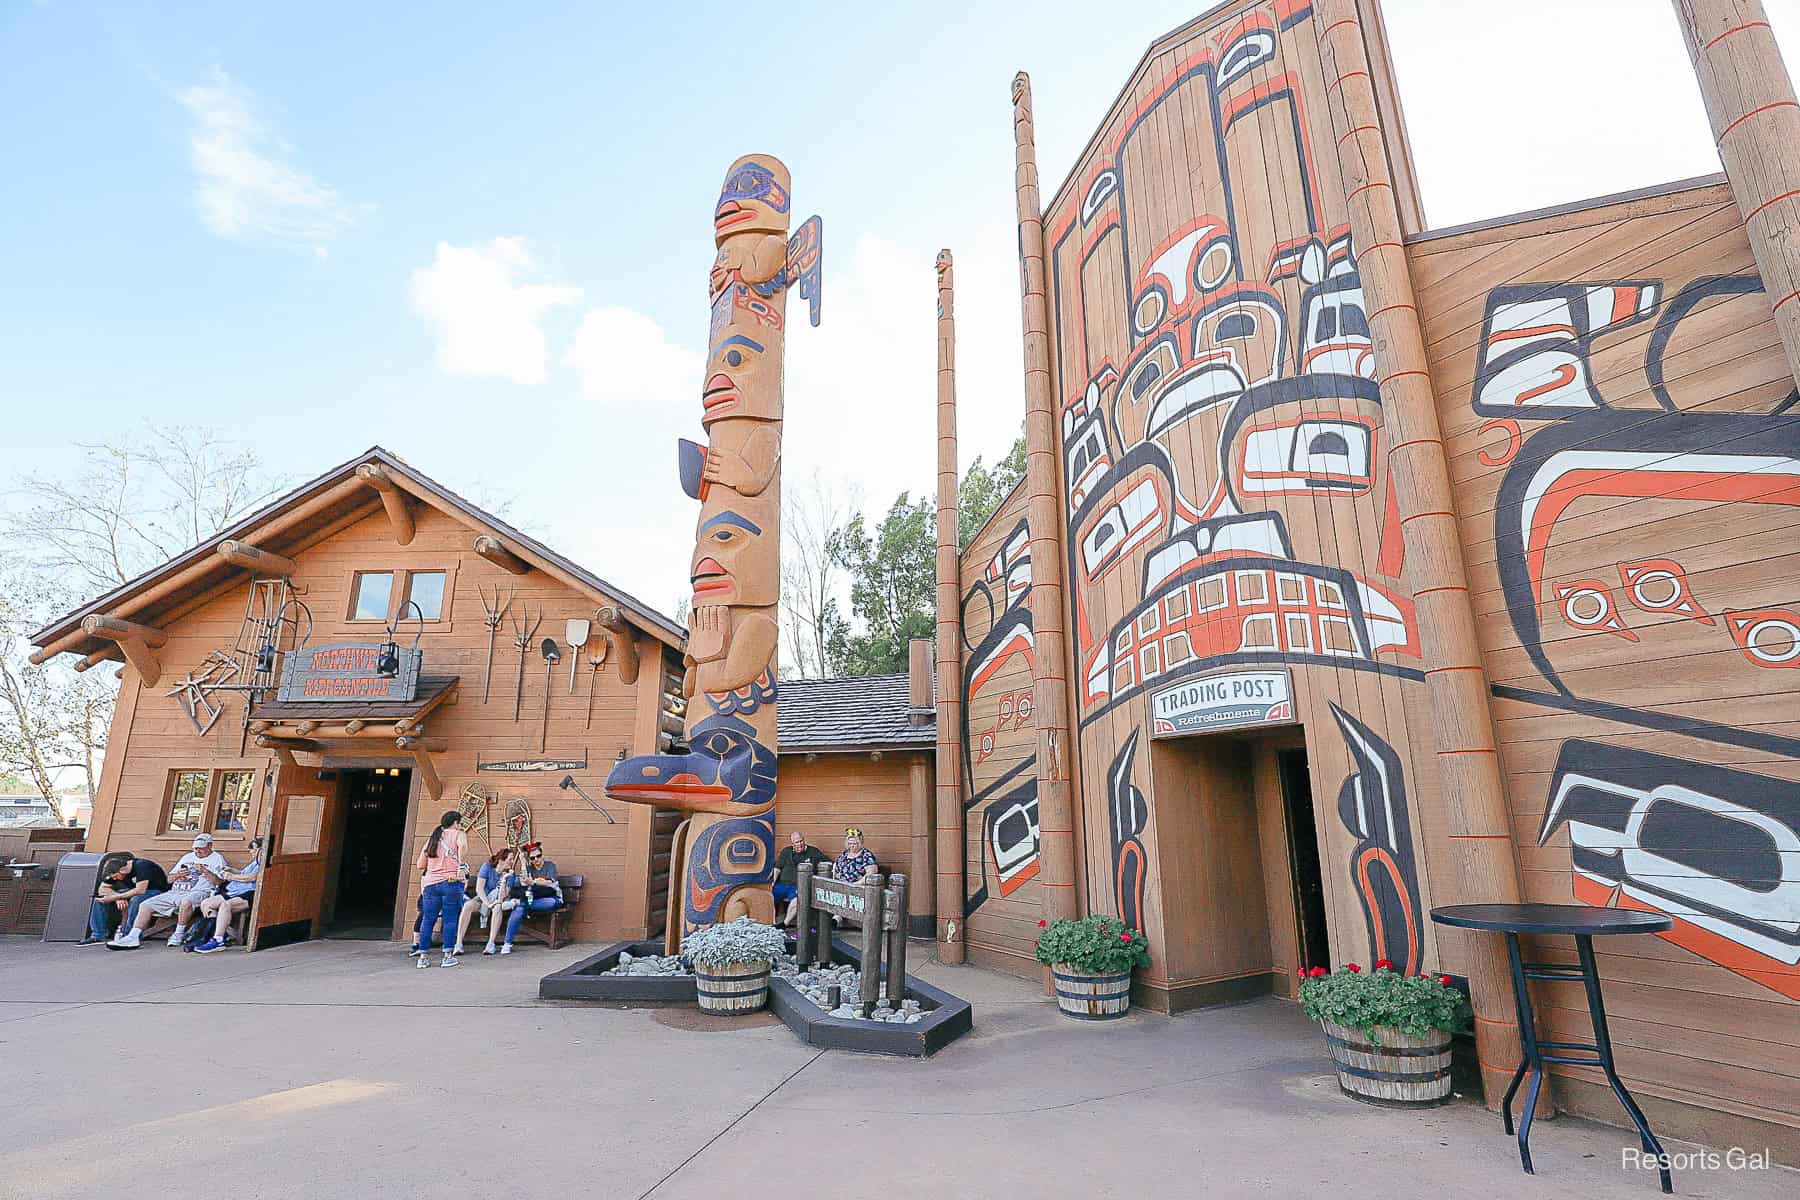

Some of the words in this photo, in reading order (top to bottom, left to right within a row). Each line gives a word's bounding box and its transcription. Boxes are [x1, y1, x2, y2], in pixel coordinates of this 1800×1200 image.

[312, 648, 377, 670] NORTHWE
[304, 678, 391, 696] MERCANTILE
[1159, 682, 1227, 713] TRADING
[1232, 679, 1274, 698] POST
[1178, 708, 1261, 726] Refreshments
